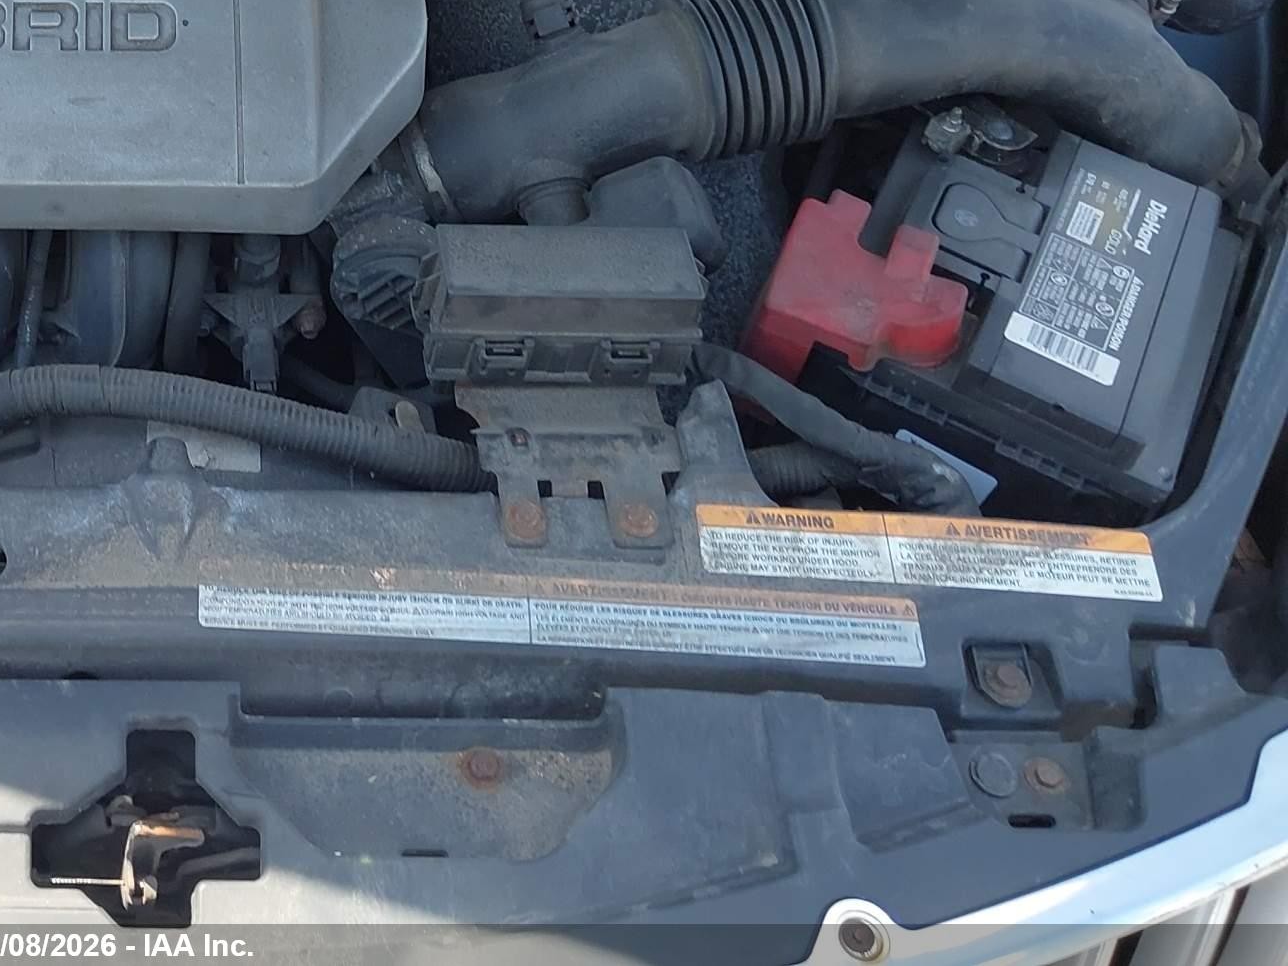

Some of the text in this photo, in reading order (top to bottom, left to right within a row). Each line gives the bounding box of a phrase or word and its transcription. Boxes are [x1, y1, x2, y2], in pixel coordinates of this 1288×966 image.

[1134, 199, 1168, 255] DieHard
[761, 513, 834, 530] WARNING
[724, 532, 760, 542] REDUCE
[764, 534, 782, 543] THE
[784, 536, 804, 545] RISK
[807, 537, 819, 546] OF
[964, 524, 1089, 545] AVERTISSEMENT
[712, 541, 880, 559] REMOVE THE KEY FROM THE IGNITION
[752, 553, 793, 564] WORKING
[798, 556, 829, 566] UNDER
[1100, 555, 1136, 565] RETIRER
[750, 563, 769, 572] MAY
[772, 564, 800, 574] START
[1119, 565, 1137, 574] DES
[1036, 571, 1074, 581] MOTEUR
[1076, 573, 1100, 583] PEUT
[1102, 575, 1112, 583] SE
[1114, 575, 1150, 586] METTRE
[775, 597, 821, 611] TENSION
[824, 601, 838, 613] DU
[841, 602, 896, 616] VÉHICULE
[710, 612, 741, 622] GRAVES
